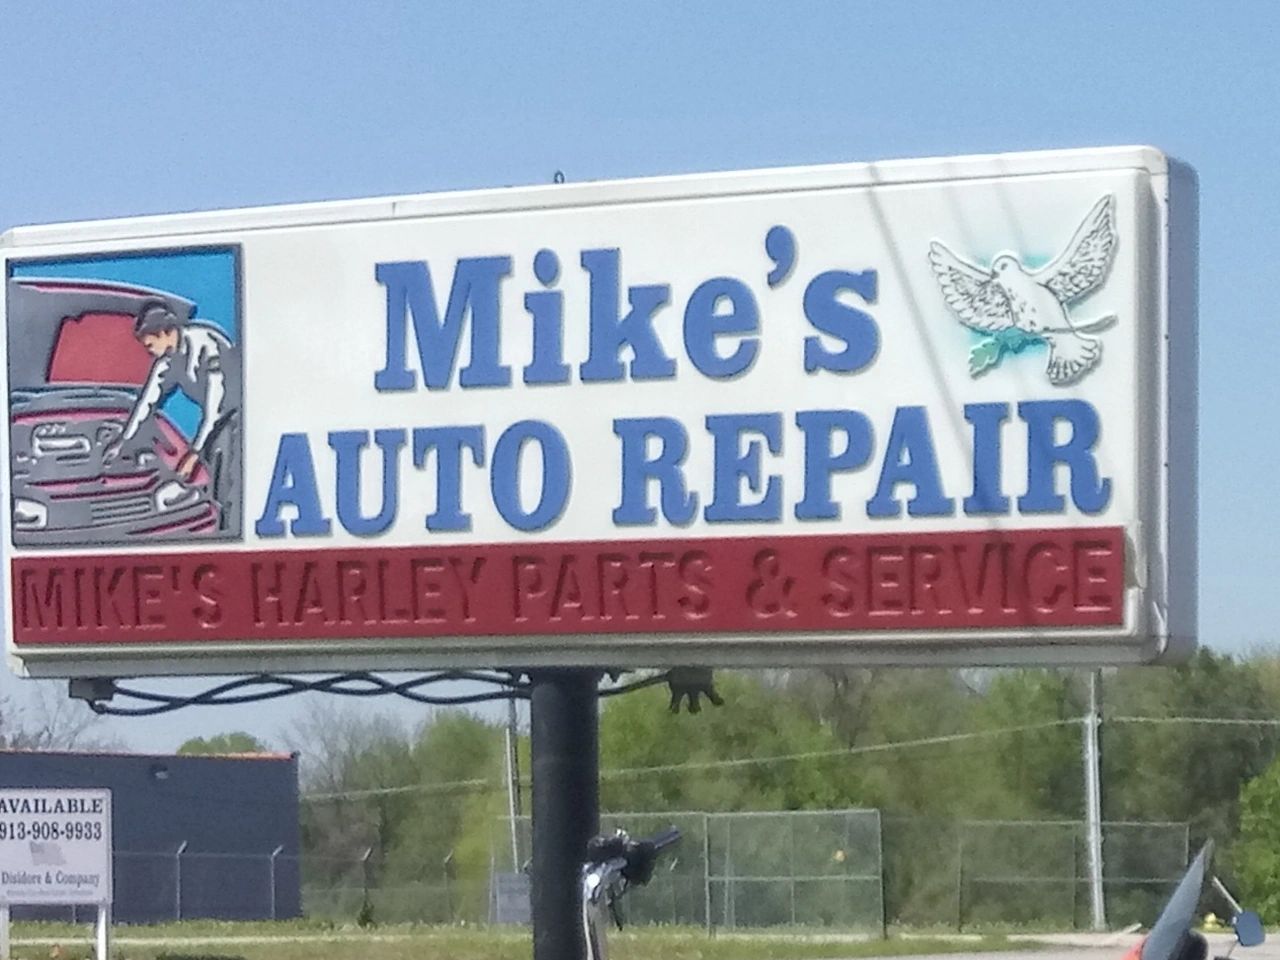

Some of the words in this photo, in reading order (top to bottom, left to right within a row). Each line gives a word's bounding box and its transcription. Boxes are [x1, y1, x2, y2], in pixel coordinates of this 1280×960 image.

[374, 223, 881, 392] Mike's
[254, 421, 574, 537] AUTO
[612, 399, 1113, 527] REPAIR
[19, 560, 226, 632] MIKE'S
[252, 555, 484, 627] HARLEY
[512, 549, 713, 622] PARTS
[746, 547, 799, 617] &
[822, 541, 1114, 614] SERVICE
[0, 798, 103, 814] AVAILABLE
[45, 872, 52, 884] &
[56, 871, 99, 887] Company
